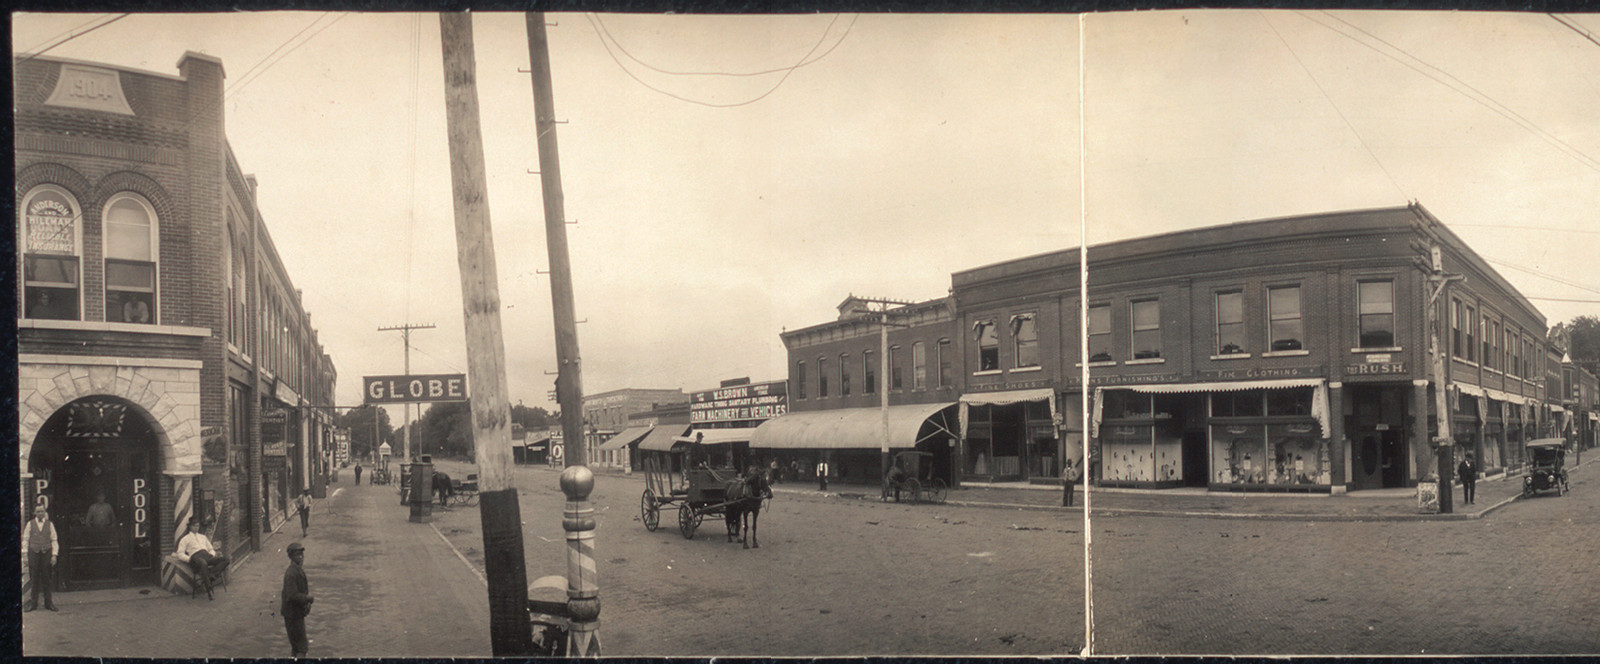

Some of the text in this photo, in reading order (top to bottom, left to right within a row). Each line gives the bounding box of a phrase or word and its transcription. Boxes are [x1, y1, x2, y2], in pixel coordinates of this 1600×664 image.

[30, 199, 70, 216] ANDERSON
[369, 379, 462, 400] GLOBE
[691, 409, 706, 421] FARM
[707, 407, 740, 420] MACHINERY
[750, 404, 787, 418] VEHICLES
[133, 478, 146, 538] POOL
